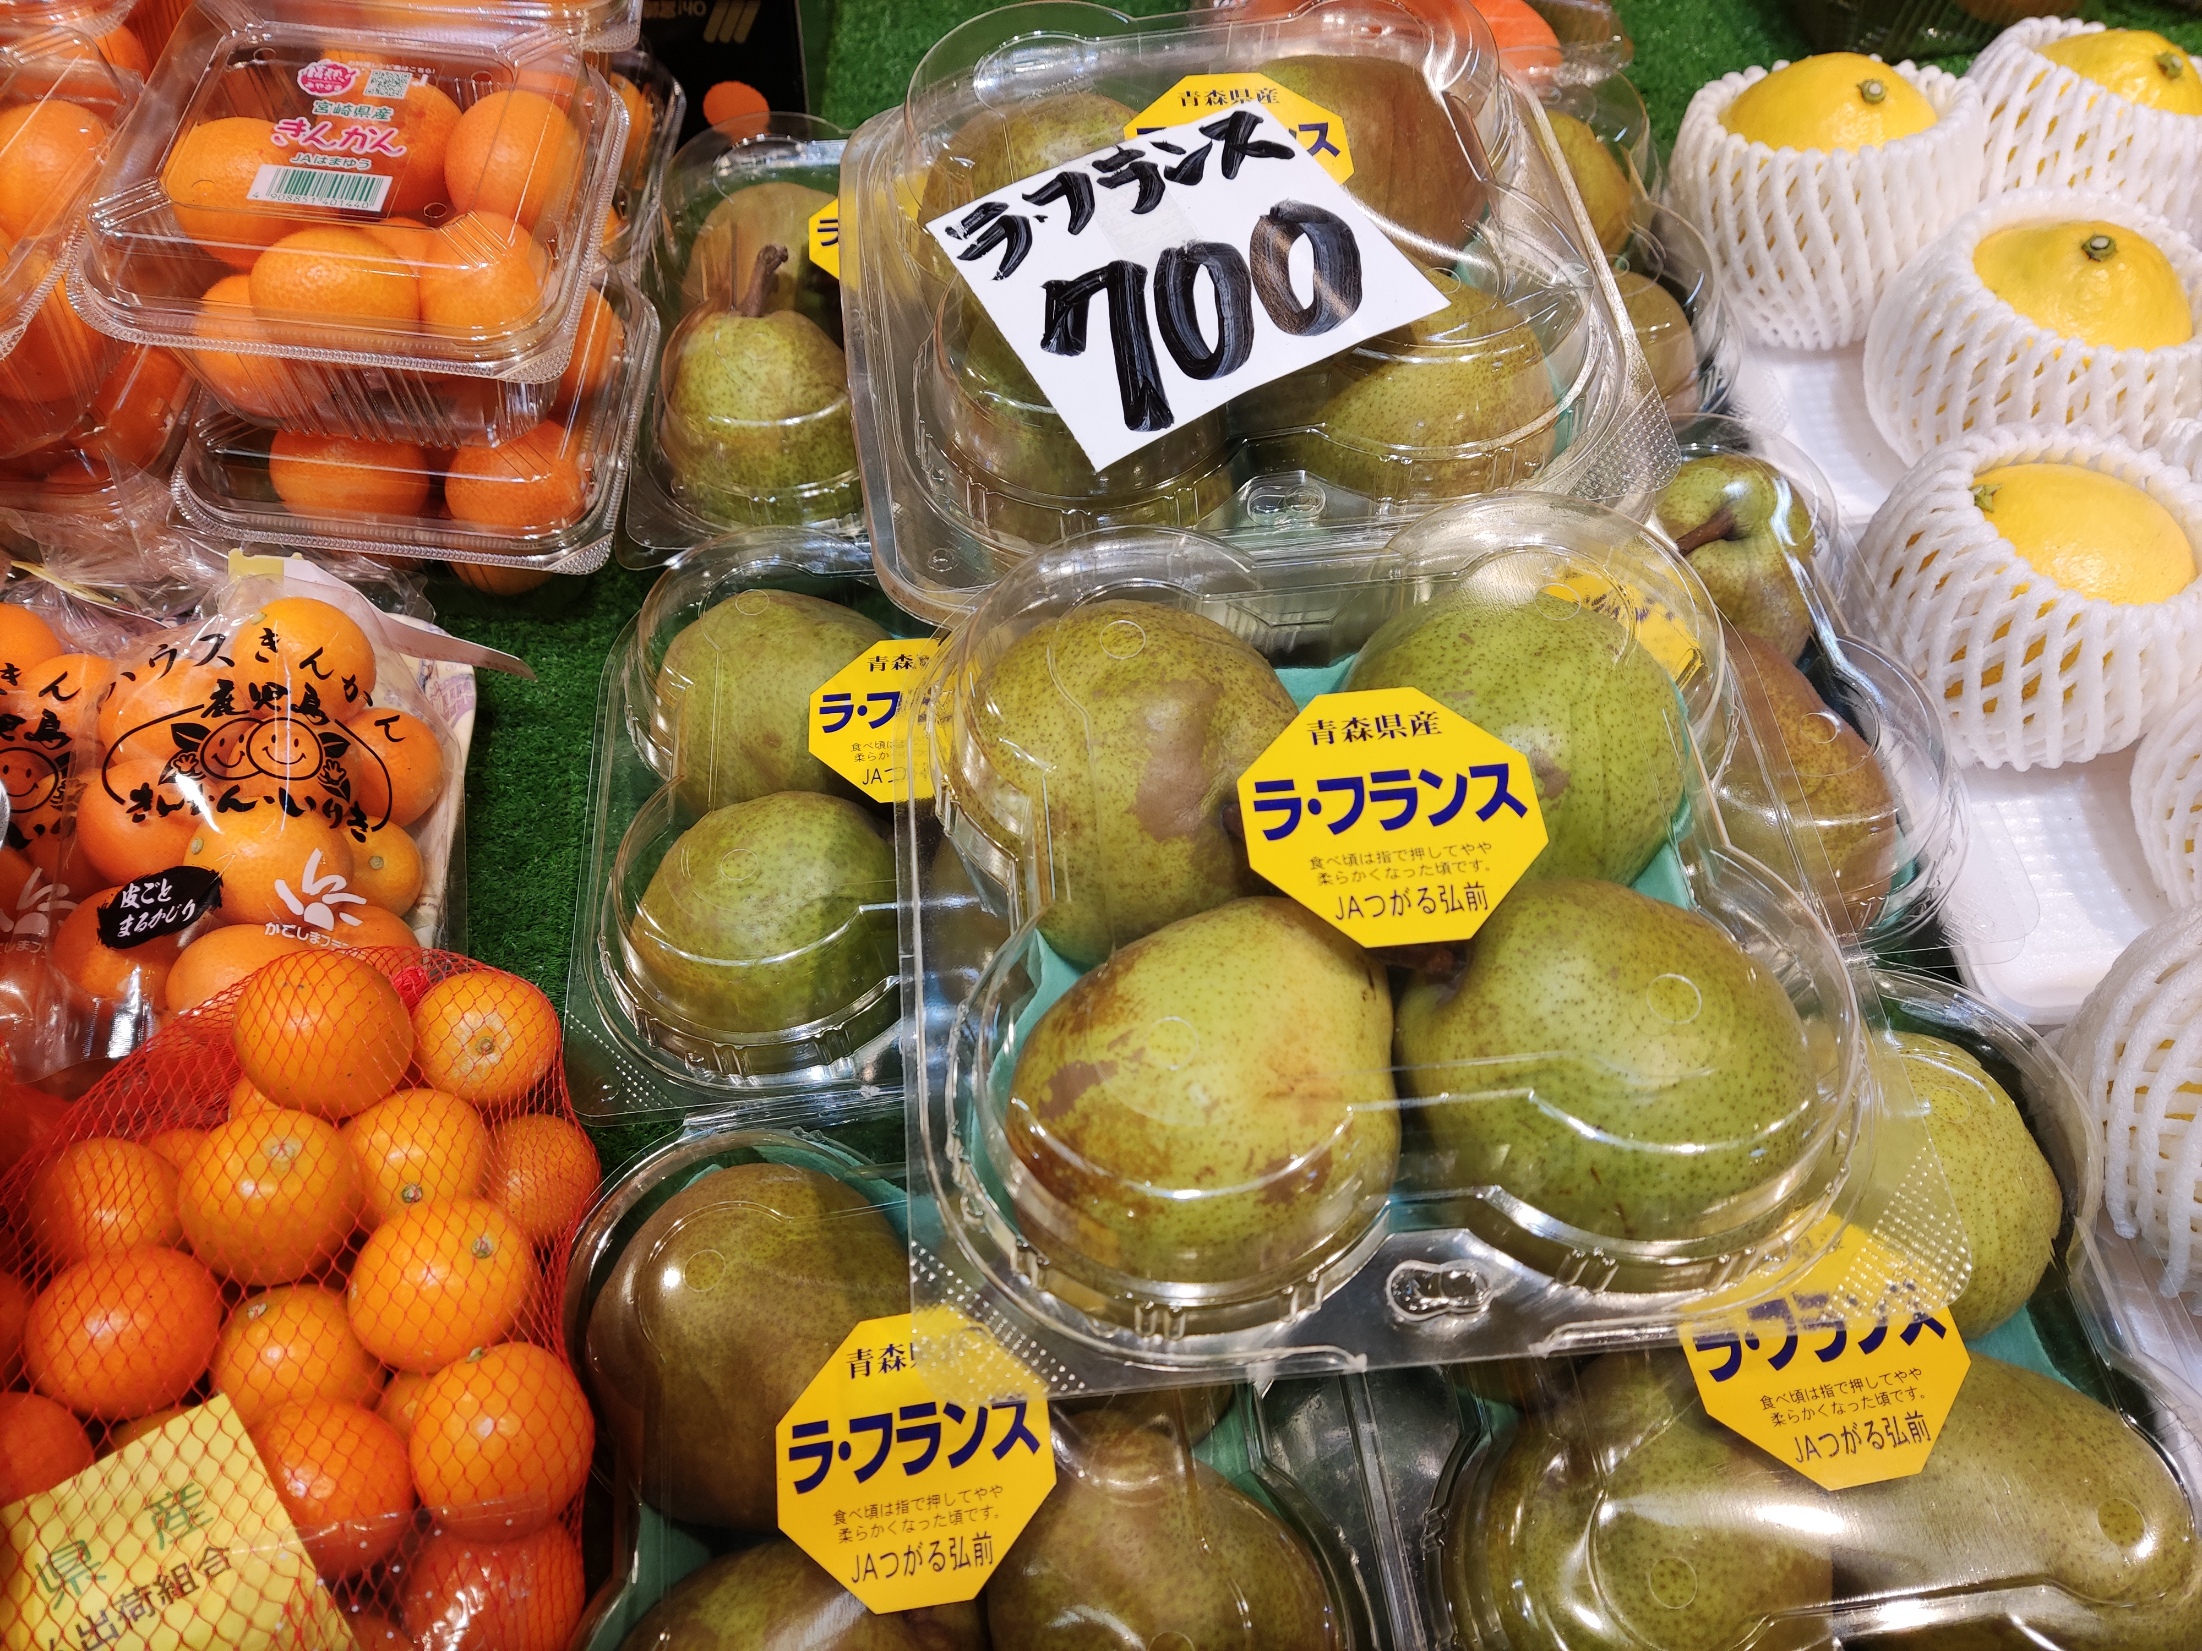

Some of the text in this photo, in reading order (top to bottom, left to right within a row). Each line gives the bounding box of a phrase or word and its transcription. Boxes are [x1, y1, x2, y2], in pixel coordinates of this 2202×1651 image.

[313, 101, 392, 120] 宮崎県産
[1177, 88, 1281, 107] 青森県産
[272, 119, 404, 154] きんかん
[291, 153, 371, 169] JAはまゆう
[945, 110, 1295, 281] ラ・フランス
[1040, 199, 1363, 432] 700
[201, 679, 330, 725] 鹿児島
[1307, 710, 1443, 746] 青森県産
[1253, 763, 1528, 841] ラ・フランス
[1310, 841, 1492, 870] 食べ頃は指で押してやや
[1317, 860, 1492, 886] 柔らかくなった頃です。
[121, 878, 173, 909] 皮ごと
[1335, 881, 1489, 921] JAつがる弘前
[117, 899, 196, 938] まるかじり
[1760, 1367, 1923, 1410] 食べ頃は指で押してやや
[1770, 1386, 1926, 1428] 柔らかくなった頃です。
[788, 1396, 1041, 1495] ラ・フランス
[1794, 1410, 1932, 1463] JAつがる弘前
[833, 1484, 1003, 1526] 食べ頃は指で押してやや
[838, 1504, 1001, 1545] 柔らかくなった頃です。
[851, 1531, 994, 1584] JAつがる弘前
[49, 1546, 231, 1651] 出荷組合
